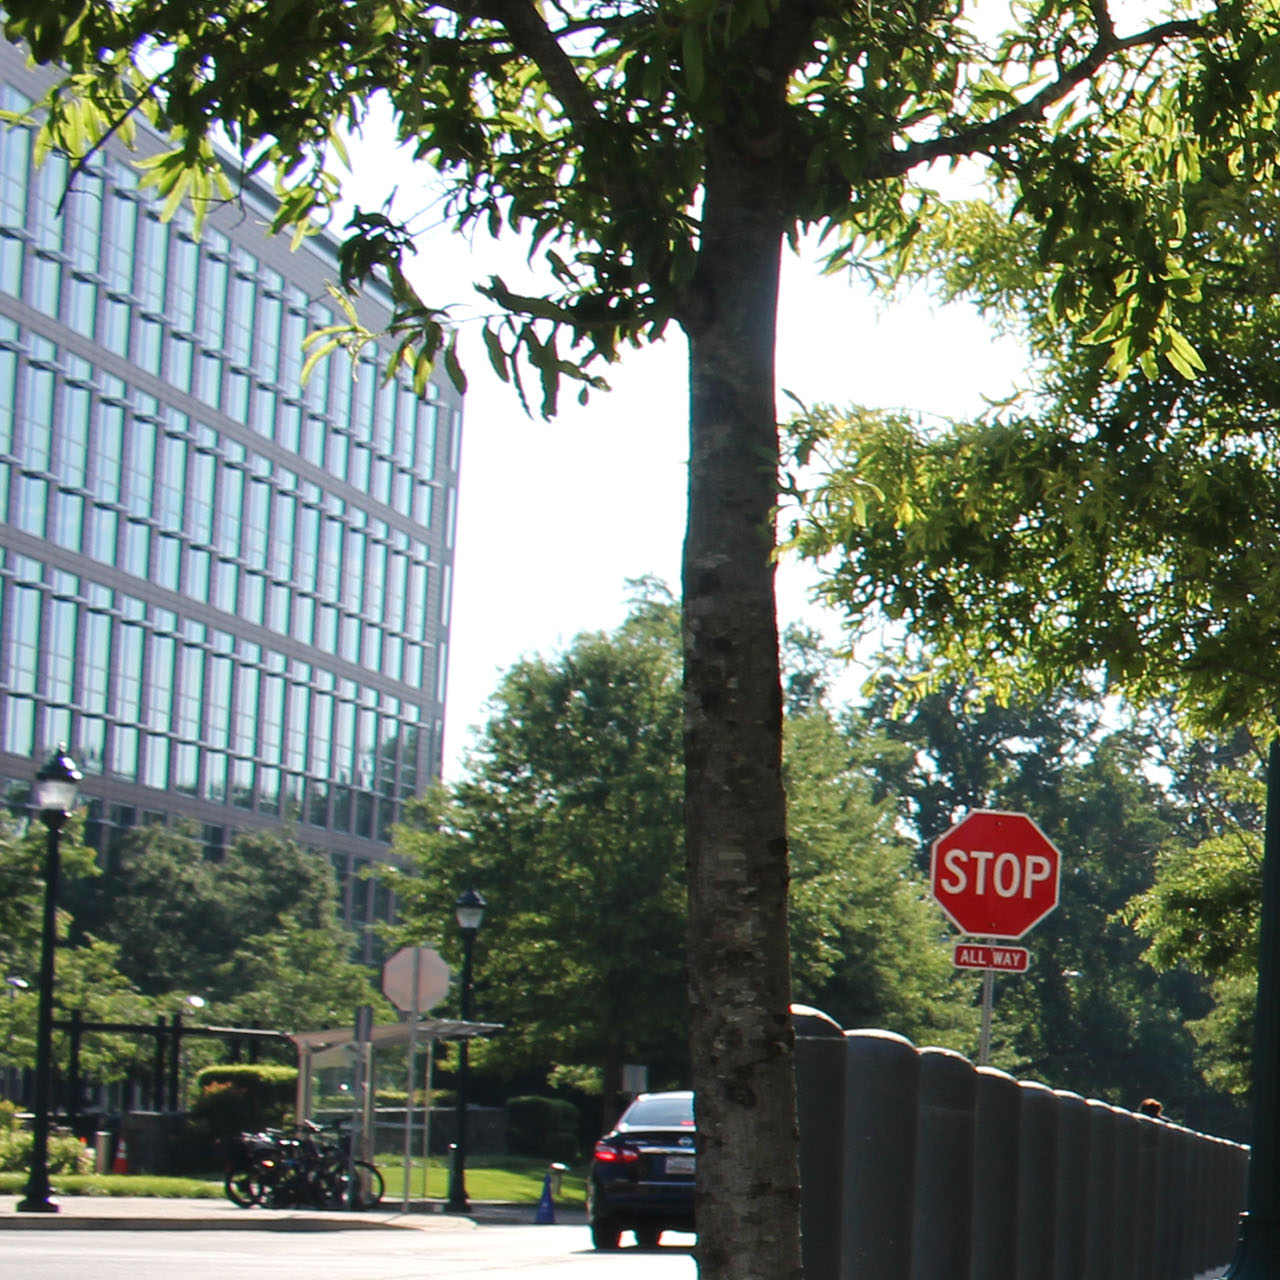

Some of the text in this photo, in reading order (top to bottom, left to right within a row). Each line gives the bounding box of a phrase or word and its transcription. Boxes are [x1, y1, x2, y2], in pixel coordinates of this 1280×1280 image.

[940, 849, 1051, 899] STOP
[960, 950, 1022, 966] ALL WAY
